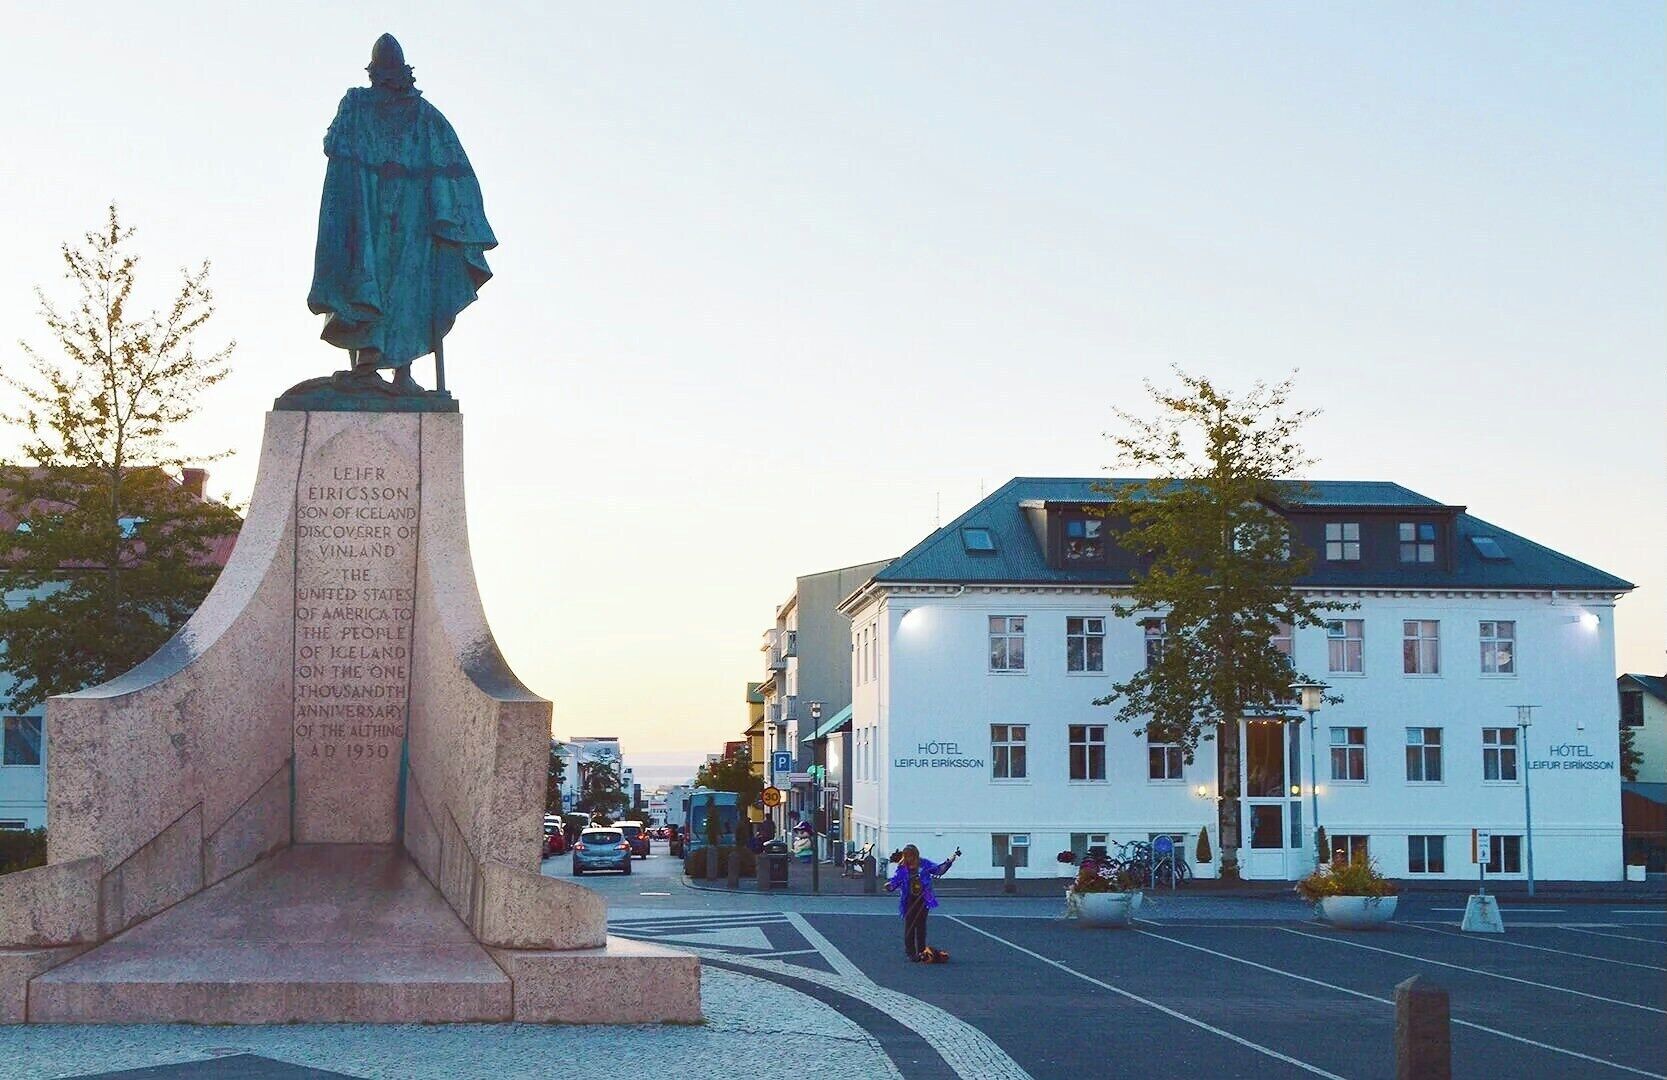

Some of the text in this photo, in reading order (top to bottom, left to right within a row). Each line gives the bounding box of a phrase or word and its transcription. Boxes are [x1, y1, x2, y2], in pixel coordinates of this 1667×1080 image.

[334, 467, 386, 480] LEIFR
[308, 486, 409, 500] EIRICSSON
[299, 506, 416, 520] SON OF ICELAND
[299, 526, 418, 538] DISCOVERER OF
[319, 544, 396, 557] VINLAND
[341, 569, 370, 581] THE
[300, 588, 414, 600] UNITED STATES
[297, 607, 413, 620] OF AMERICA TO
[303, 627, 406, 640] THE PEOPLE
[300, 646, 406, 660] OF ICELAND
[300, 665, 406, 678] ON THE ONE
[299, 685, 406, 698] THOUSANDTH
[297, 705, 406, 718] ANNIVERSARY
[296, 725, 404, 738] OF THE ALTHING
[347, 744, 389, 759] 1930
[778, 757, 787, 769] P
[894, 759, 929, 768] LEIFUR
[1527, 761, 1560, 770] LEIFUR
[765, 792, 779, 801] 30
